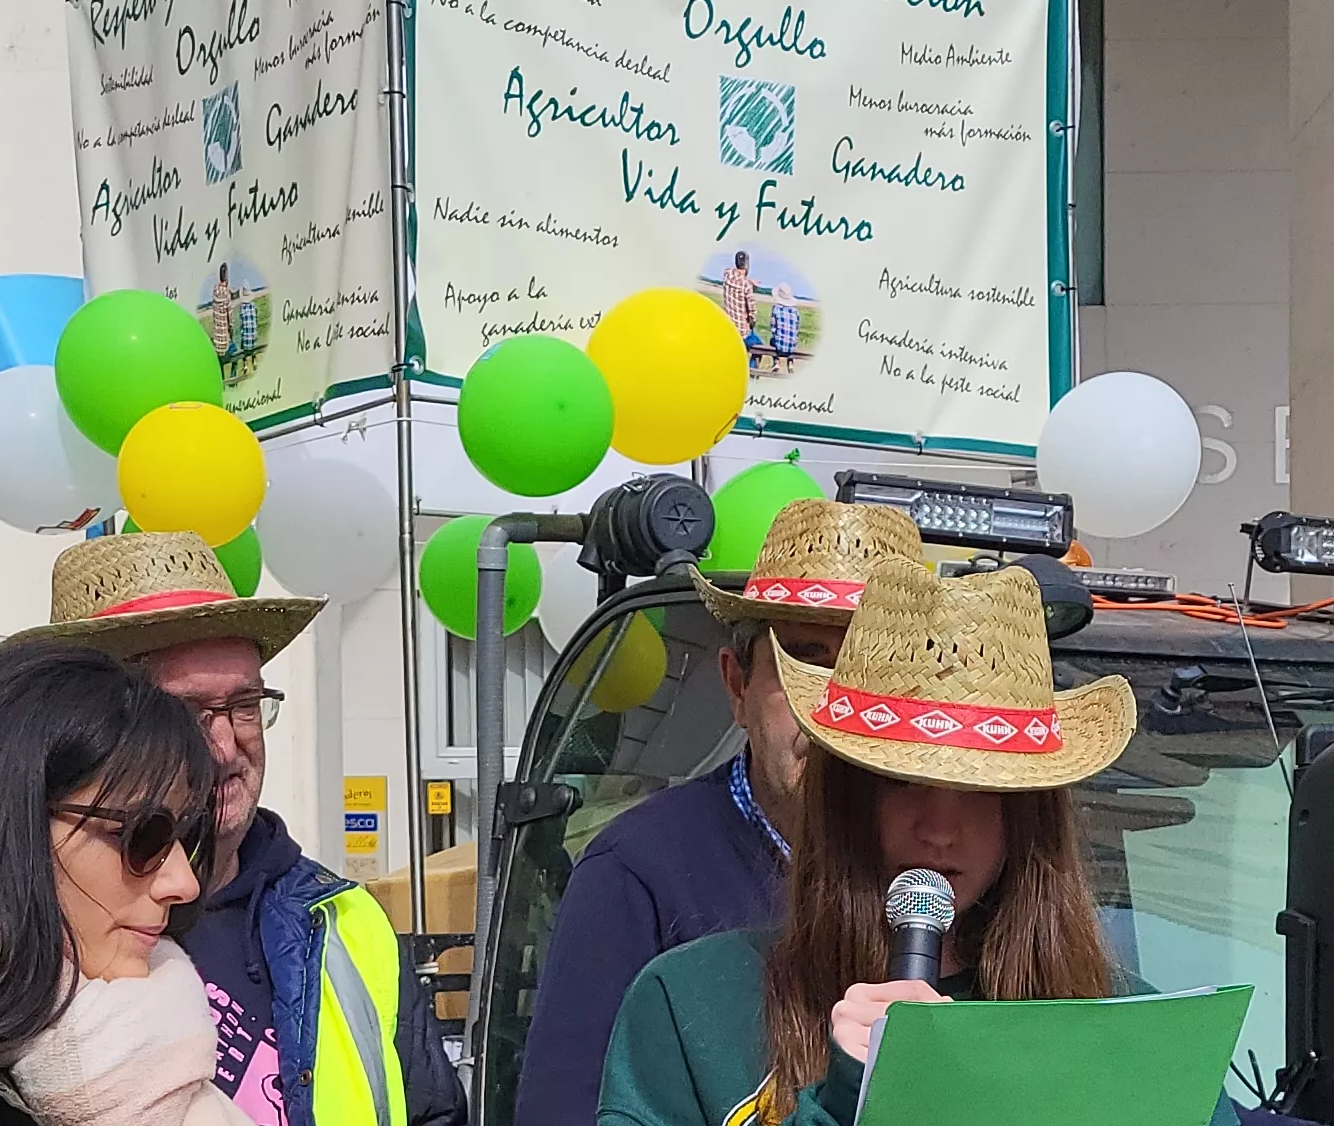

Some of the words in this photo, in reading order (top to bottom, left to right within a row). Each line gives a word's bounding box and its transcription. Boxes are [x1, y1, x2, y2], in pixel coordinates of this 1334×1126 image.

[176, 0, 261, 85] Orgullo
[479, 0, 497, 25] la
[615, 49, 671, 83] desleal
[683, 0, 827, 68] Orgullo
[901, 41, 942, 66] Medio
[946, 43, 1012, 68] Ambiente
[266, 79, 358, 152] Ganadero
[503, 65, 681, 146] Agricultor
[848, 84, 893, 111] Menos
[898, 90, 974, 116] burocracia
[924, 121, 956, 141] más
[960, 119, 1032, 147] formación
[832, 135, 966, 192] Ganadero
[91, 155, 182, 237] Agricultor
[622, 147, 700, 214] Vida
[714, 201, 741, 241] y
[755, 179, 874, 242] Futuro
[153, 207, 199, 263] Vida
[204, 217, 220, 263] y
[227, 178, 298, 239] Futuro
[281, 221, 341, 266] Agricultura
[433, 196, 491, 225] Nadie
[497, 209, 530, 231] sin
[535, 213, 619, 248] alimentos
[444, 281, 500, 313] Apoyo
[507, 283, 520, 301] a
[527, 275, 548, 300] la
[879, 266, 963, 299] Agricultura
[967, 281, 1036, 308] sostenible
[297, 328, 310, 353] No
[347, 311, 390, 339] social
[480, 310, 574, 348] ganadería
[857, 318, 935, 356] Ganadería
[939, 341, 1009, 372] intensiva
[880, 354, 902, 378] No
[905, 367, 916, 382] a
[920, 363, 936, 385] la
[940, 370, 972, 395] peste
[976, 384, 1022, 405] social
[866, 712, 893, 723] KUHN
[918, 718, 954, 730] KUHN
[982, 724, 1012, 735] KUHN
